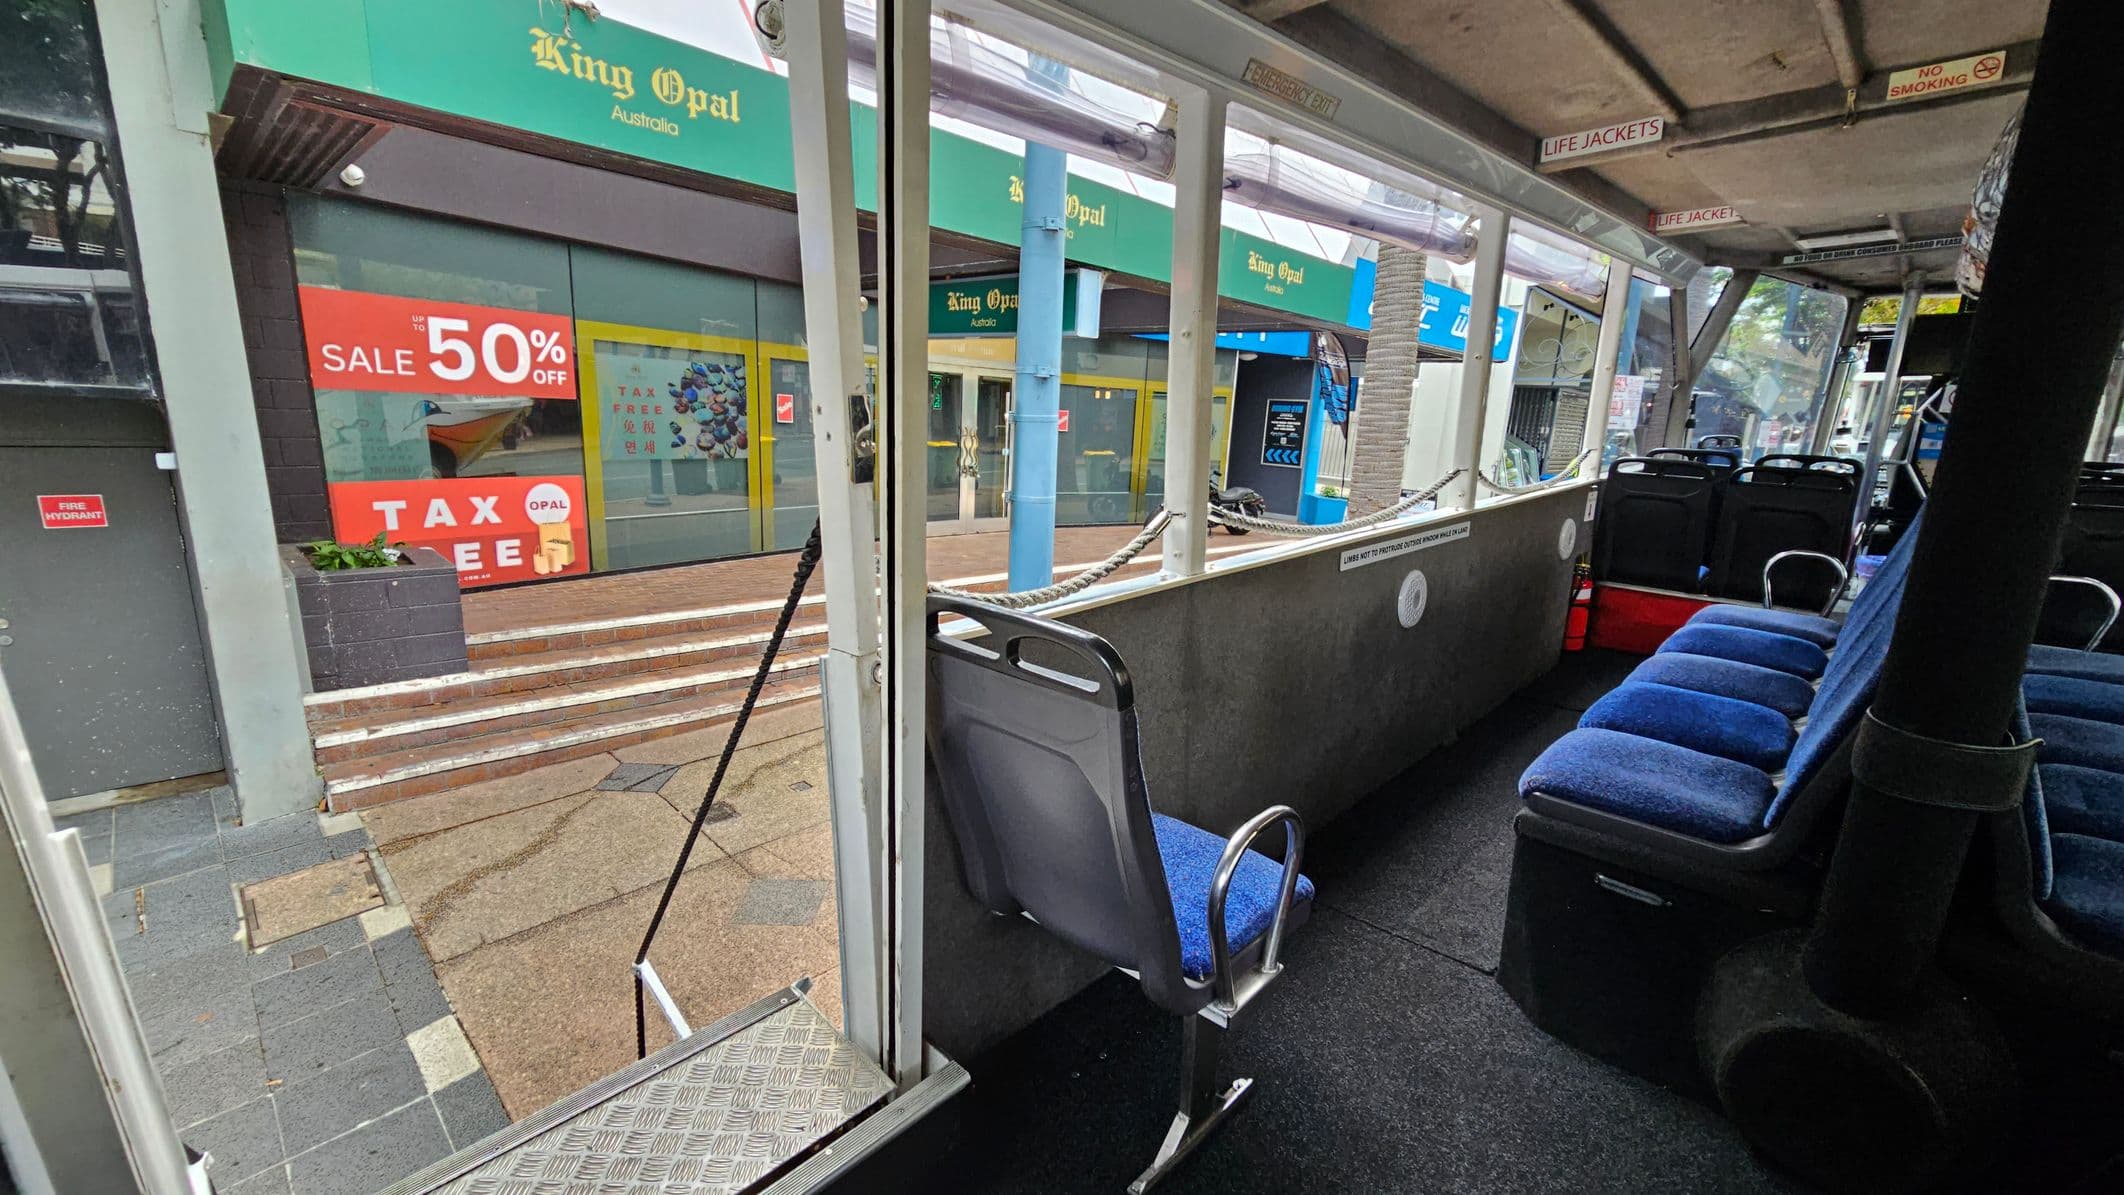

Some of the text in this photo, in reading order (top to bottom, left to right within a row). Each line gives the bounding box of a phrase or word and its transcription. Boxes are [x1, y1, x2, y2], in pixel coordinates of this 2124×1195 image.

[529, 27, 741, 123] King Opal
[1919, 65, 1943, 79] NO
[1252, 66, 1334, 113] EMERGENCY EXIT
[1890, 74, 1968, 97] SMOKING
[611, 105, 679, 136] Australia
[1544, 119, 1659, 156] LIFE JACKETS
[1065, 194, 1105, 227] Opal
[1658, 207, 1737, 227] LIFE JACKET
[1248, 250, 1304, 285] King Opal
[947, 288, 1019, 314] King Opa
[412, 323, 425, 331] TO
[970, 317, 997, 328] Australia
[321, 315, 567, 384] SALE 50%
[533, 369, 567, 386] OFF
[617, 385, 656, 398] TAX
[613, 403, 664, 415] FREE
[45, 511, 103, 521] HYDRANT
[58, 501, 87, 511] FIRE
[372, 495, 503, 531] TAX
[529, 500, 567, 511] OPAL
[454, 538, 523, 571] EE
[1343, 526, 1469, 565] LIMBS NOT TO PROTRUDE OUTSIDE WINDOW WHILE ON LAND
